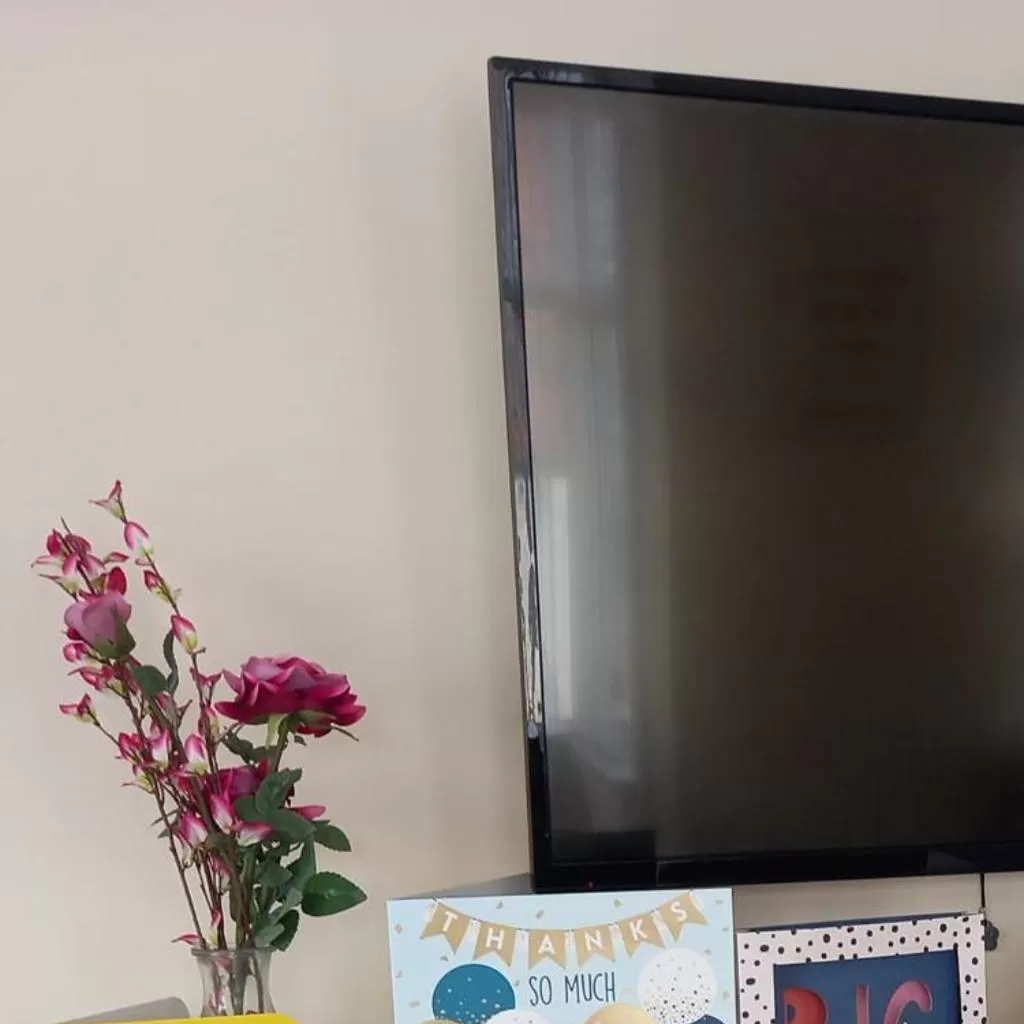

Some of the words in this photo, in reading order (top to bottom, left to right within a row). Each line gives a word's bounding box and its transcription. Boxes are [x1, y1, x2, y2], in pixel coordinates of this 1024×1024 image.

[443, 900, 690, 956] THANKS
[527, 974, 552, 1007] SO
[563, 971, 617, 1005] MUCH
